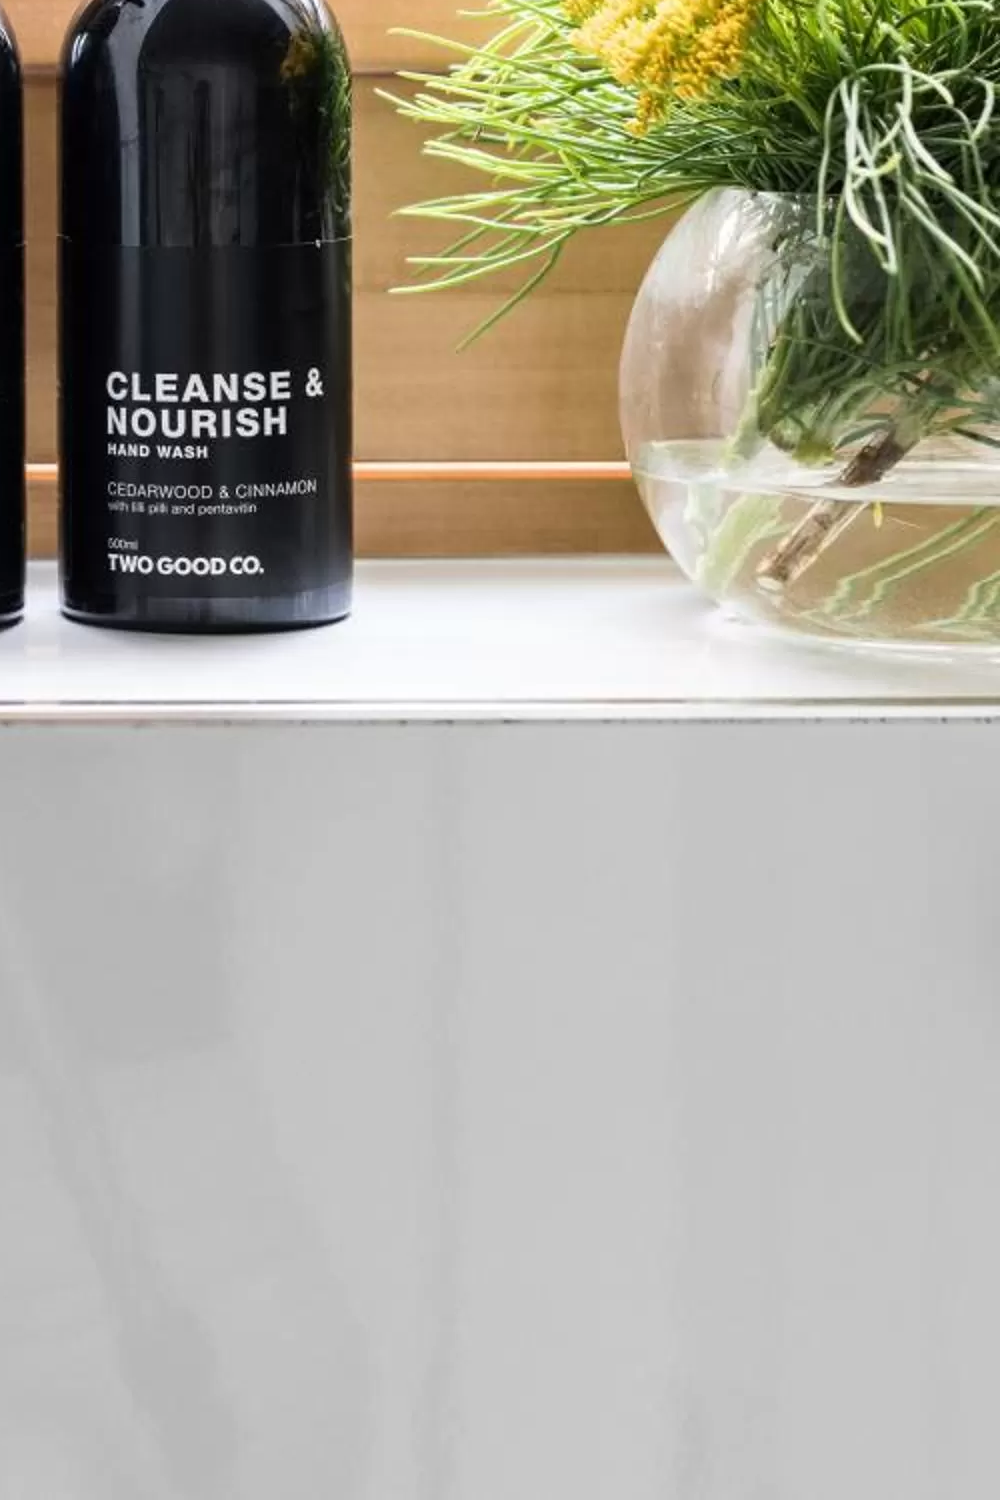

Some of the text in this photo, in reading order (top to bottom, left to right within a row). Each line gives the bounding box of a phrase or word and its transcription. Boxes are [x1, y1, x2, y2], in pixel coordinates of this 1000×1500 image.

[106, 367, 324, 403] CLEANSE &
[107, 406, 287, 439] NOURISH
[107, 443, 208, 459] HAND WASH
[107, 479, 317, 499] CEDARWOOD & CINNAMON
[107, 501, 129, 513] with
[171, 503, 195, 515] and
[197, 503, 257, 517] pentavitin
[107, 553, 265, 576] TWO GOOD CO.
